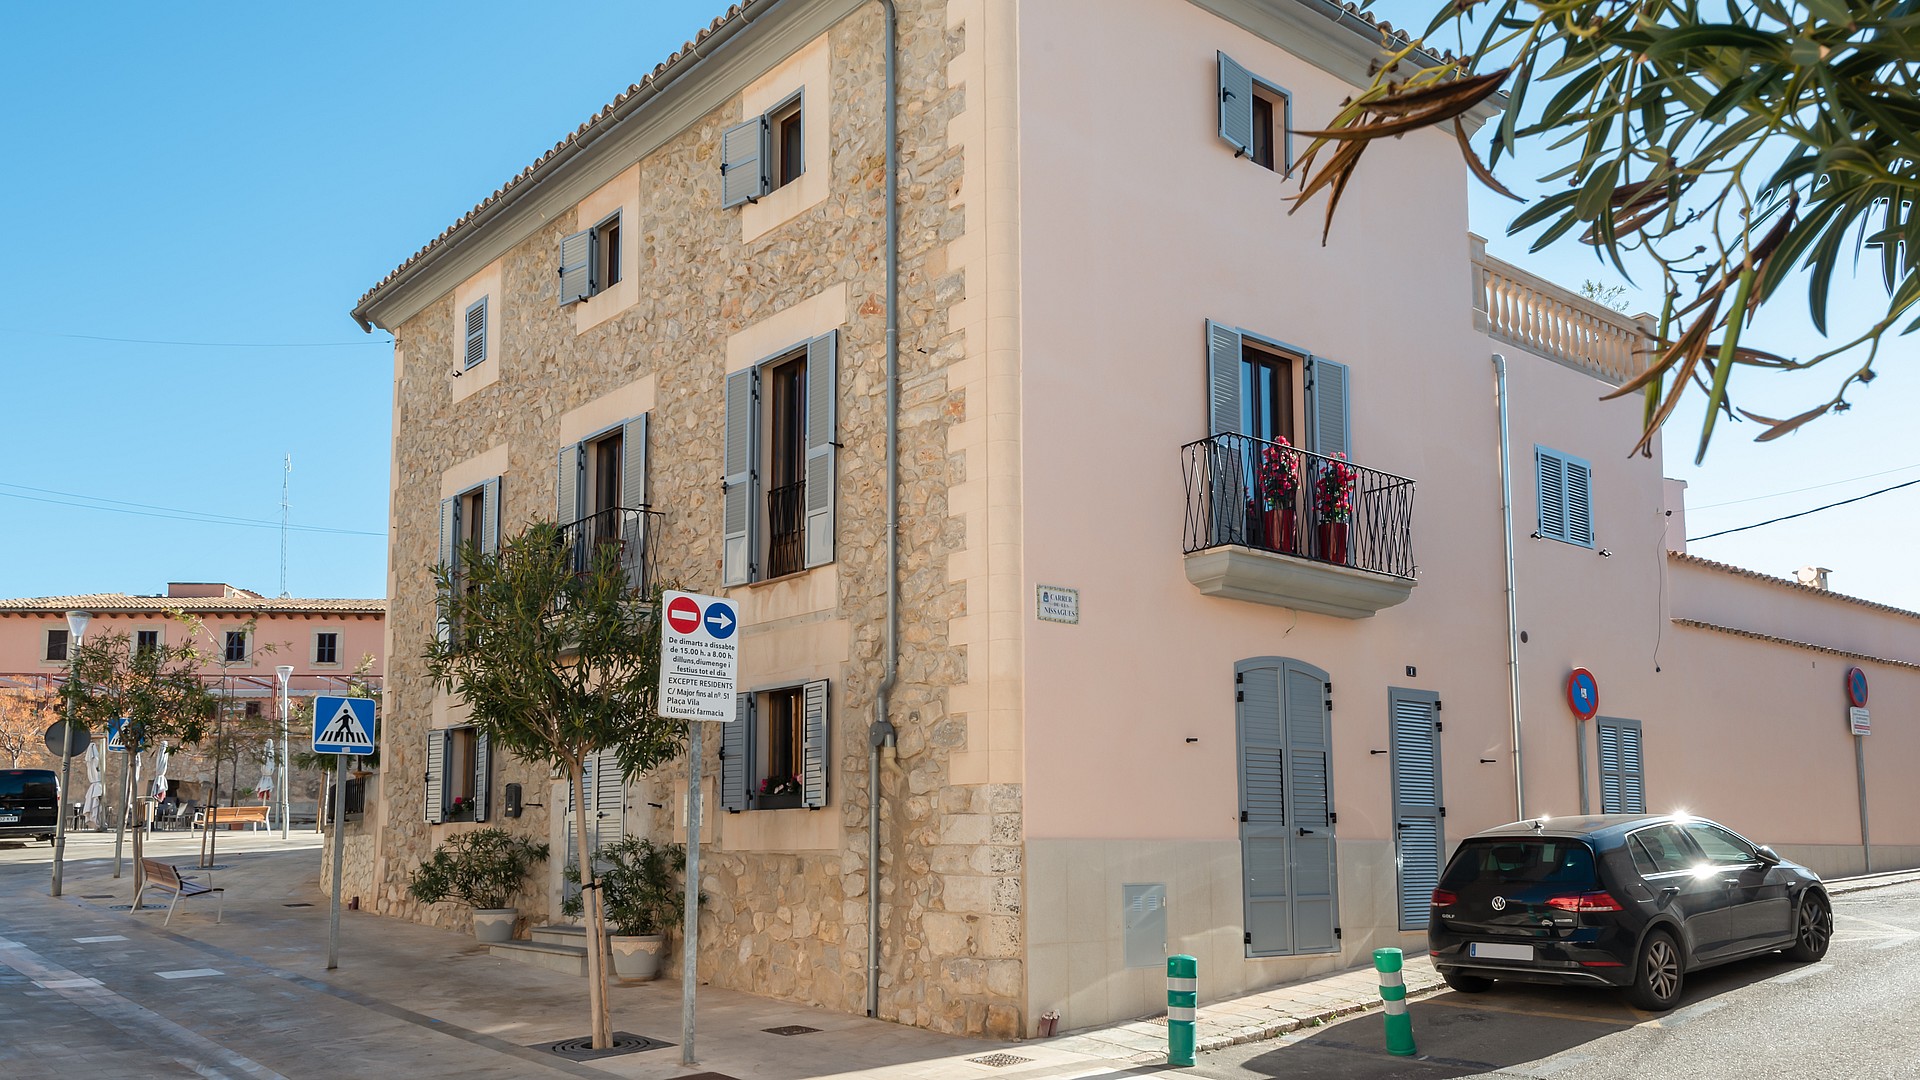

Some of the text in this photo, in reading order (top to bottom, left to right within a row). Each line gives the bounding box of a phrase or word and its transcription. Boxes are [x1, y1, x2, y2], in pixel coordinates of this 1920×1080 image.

[1050, 594, 1073, 603] CARRER
[668, 636, 678, 644] De
[679, 638, 703, 647] dimarts
[709, 642, 735, 651] dissabte
[680, 647, 699, 655] 15.00
[712, 651, 727, 659] 8.00
[676, 665, 698, 674] festius
[668, 677, 734, 690] EXCEPTE RESIDENTS
[667, 687, 676, 695] C/
[676, 688, 695, 697] Major
[723, 692, 730, 700] 51
[666, 696, 700, 706] Plaça Vila
[670, 706, 695, 715] Usuaris
[696, 707, 724, 717] farmacia
